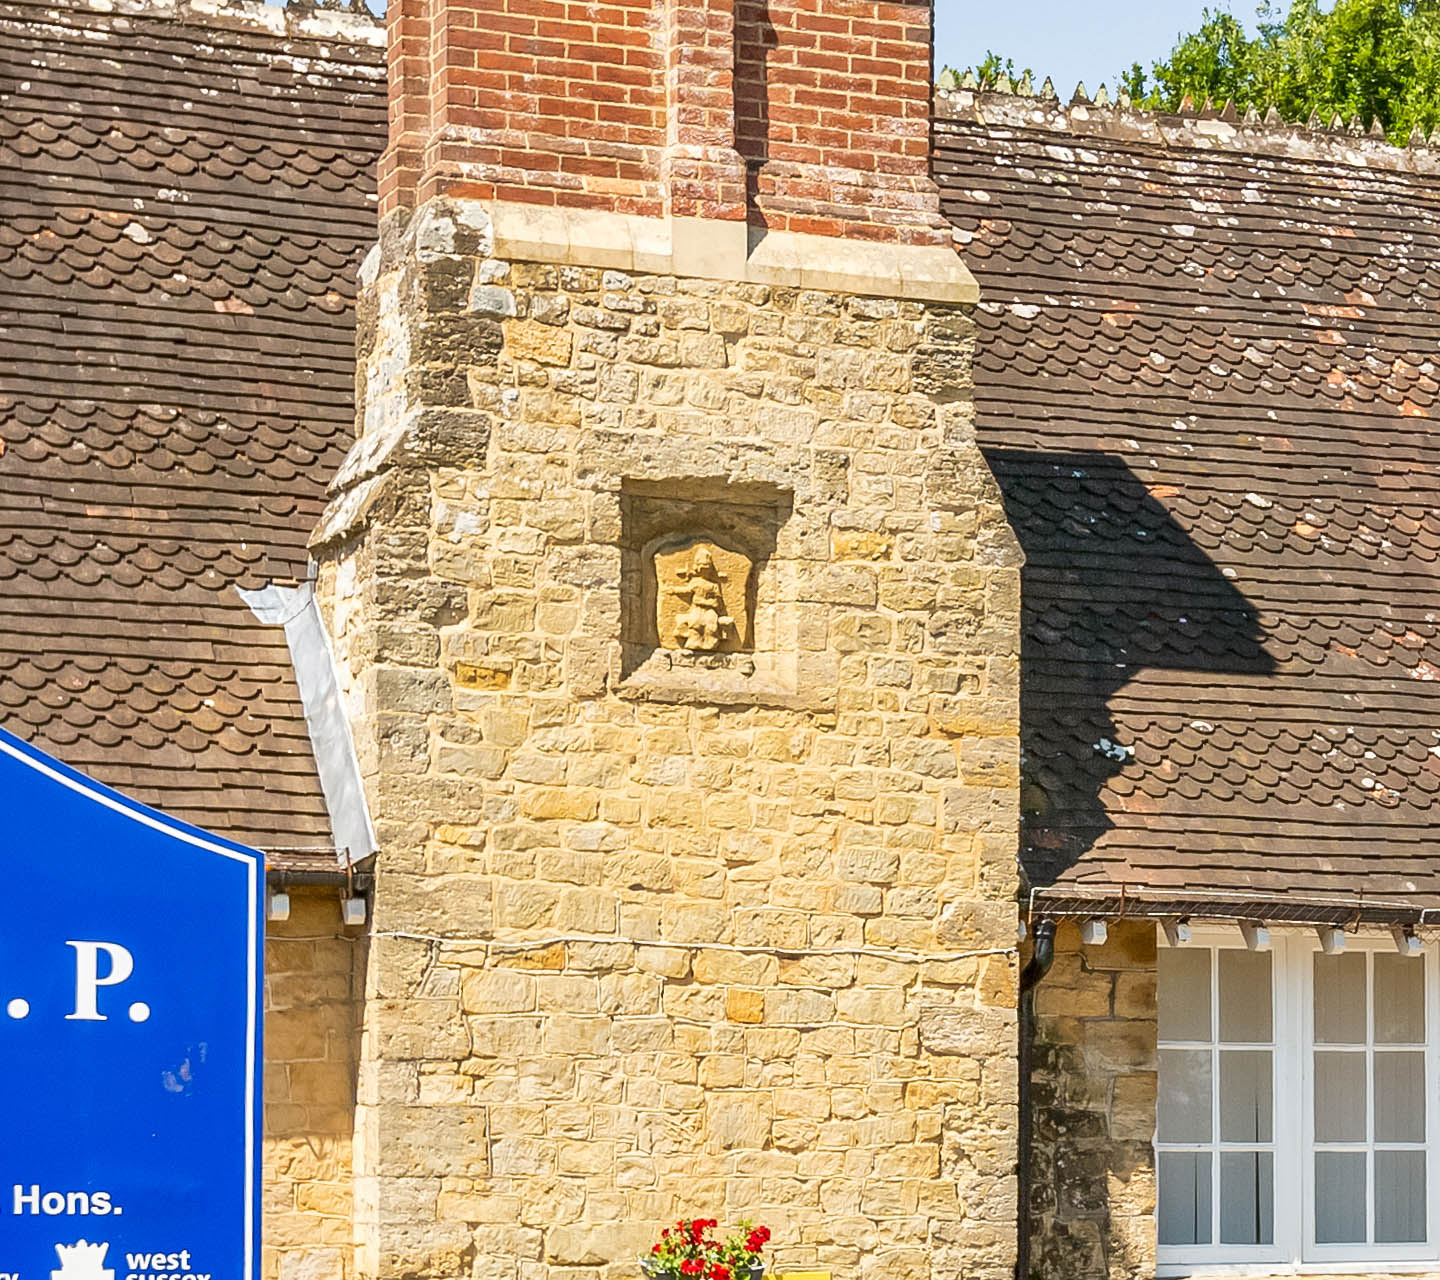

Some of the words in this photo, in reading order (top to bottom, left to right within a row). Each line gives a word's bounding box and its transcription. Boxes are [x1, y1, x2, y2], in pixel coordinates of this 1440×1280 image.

[64, 940, 150, 1023] P.
[13, 1184, 123, 1215] Hons.
[125, 1249, 191, 1271] west
